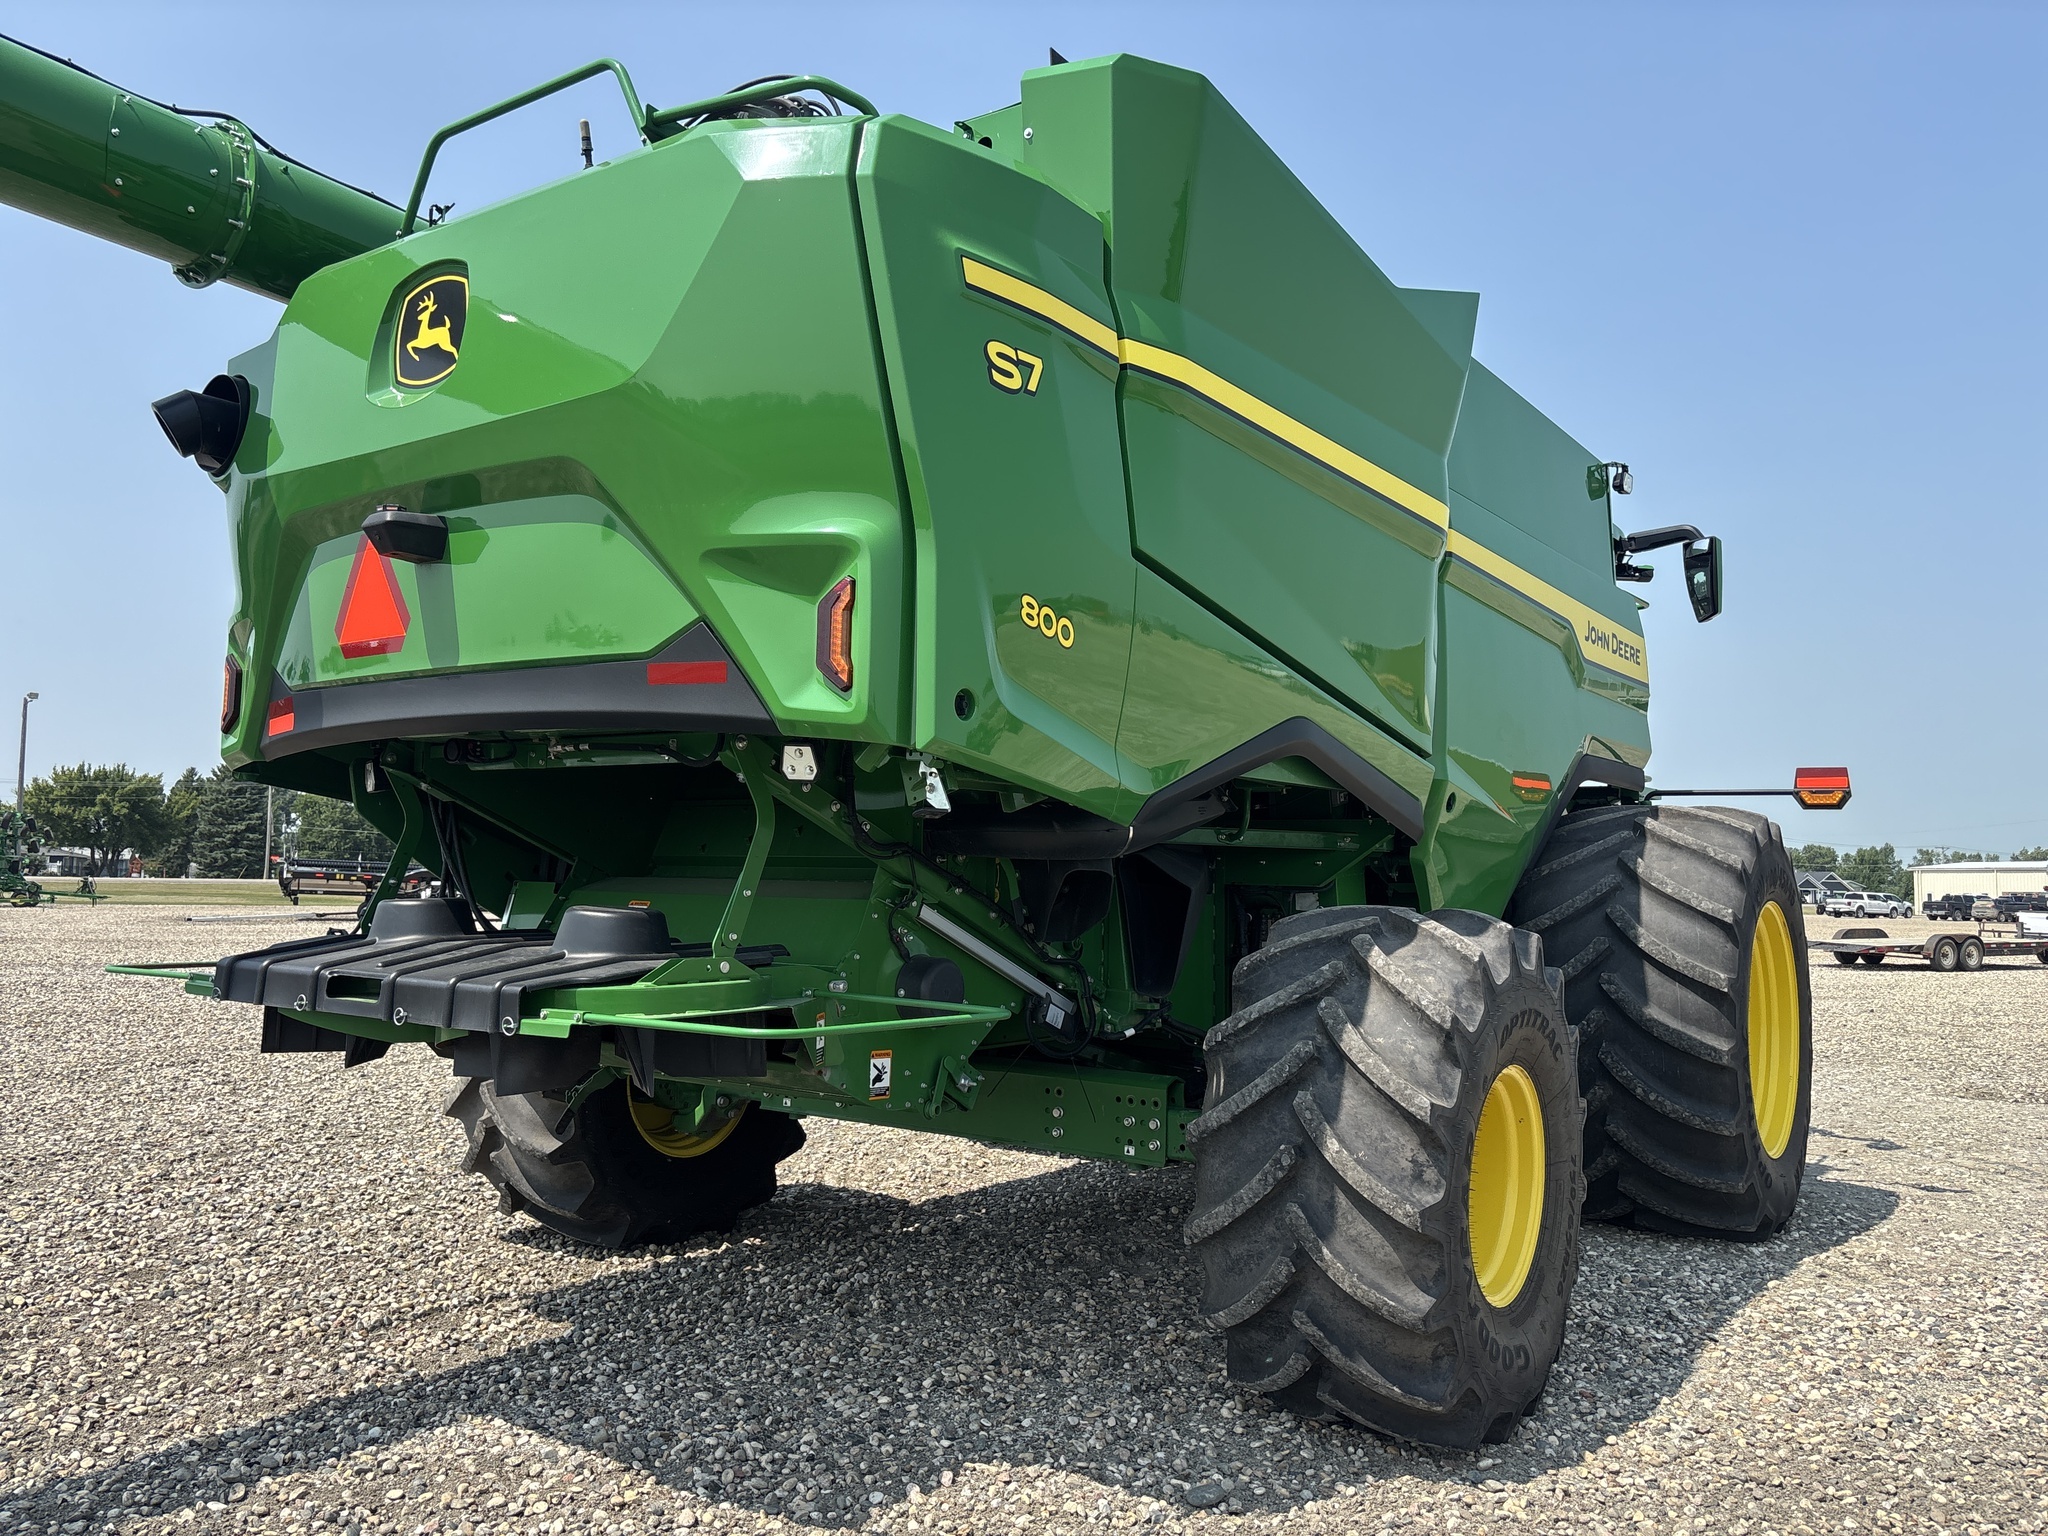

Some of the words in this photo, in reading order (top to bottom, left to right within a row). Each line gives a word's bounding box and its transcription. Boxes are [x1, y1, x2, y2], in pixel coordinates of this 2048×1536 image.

[984, 339, 1043, 397] S7
[1020, 593, 1075, 649] 800
[1584, 620, 1610, 652] JOHN
[1611, 632, 1641, 667] DEERE
[1500, 1007, 1563, 1062] OPTITRAC
